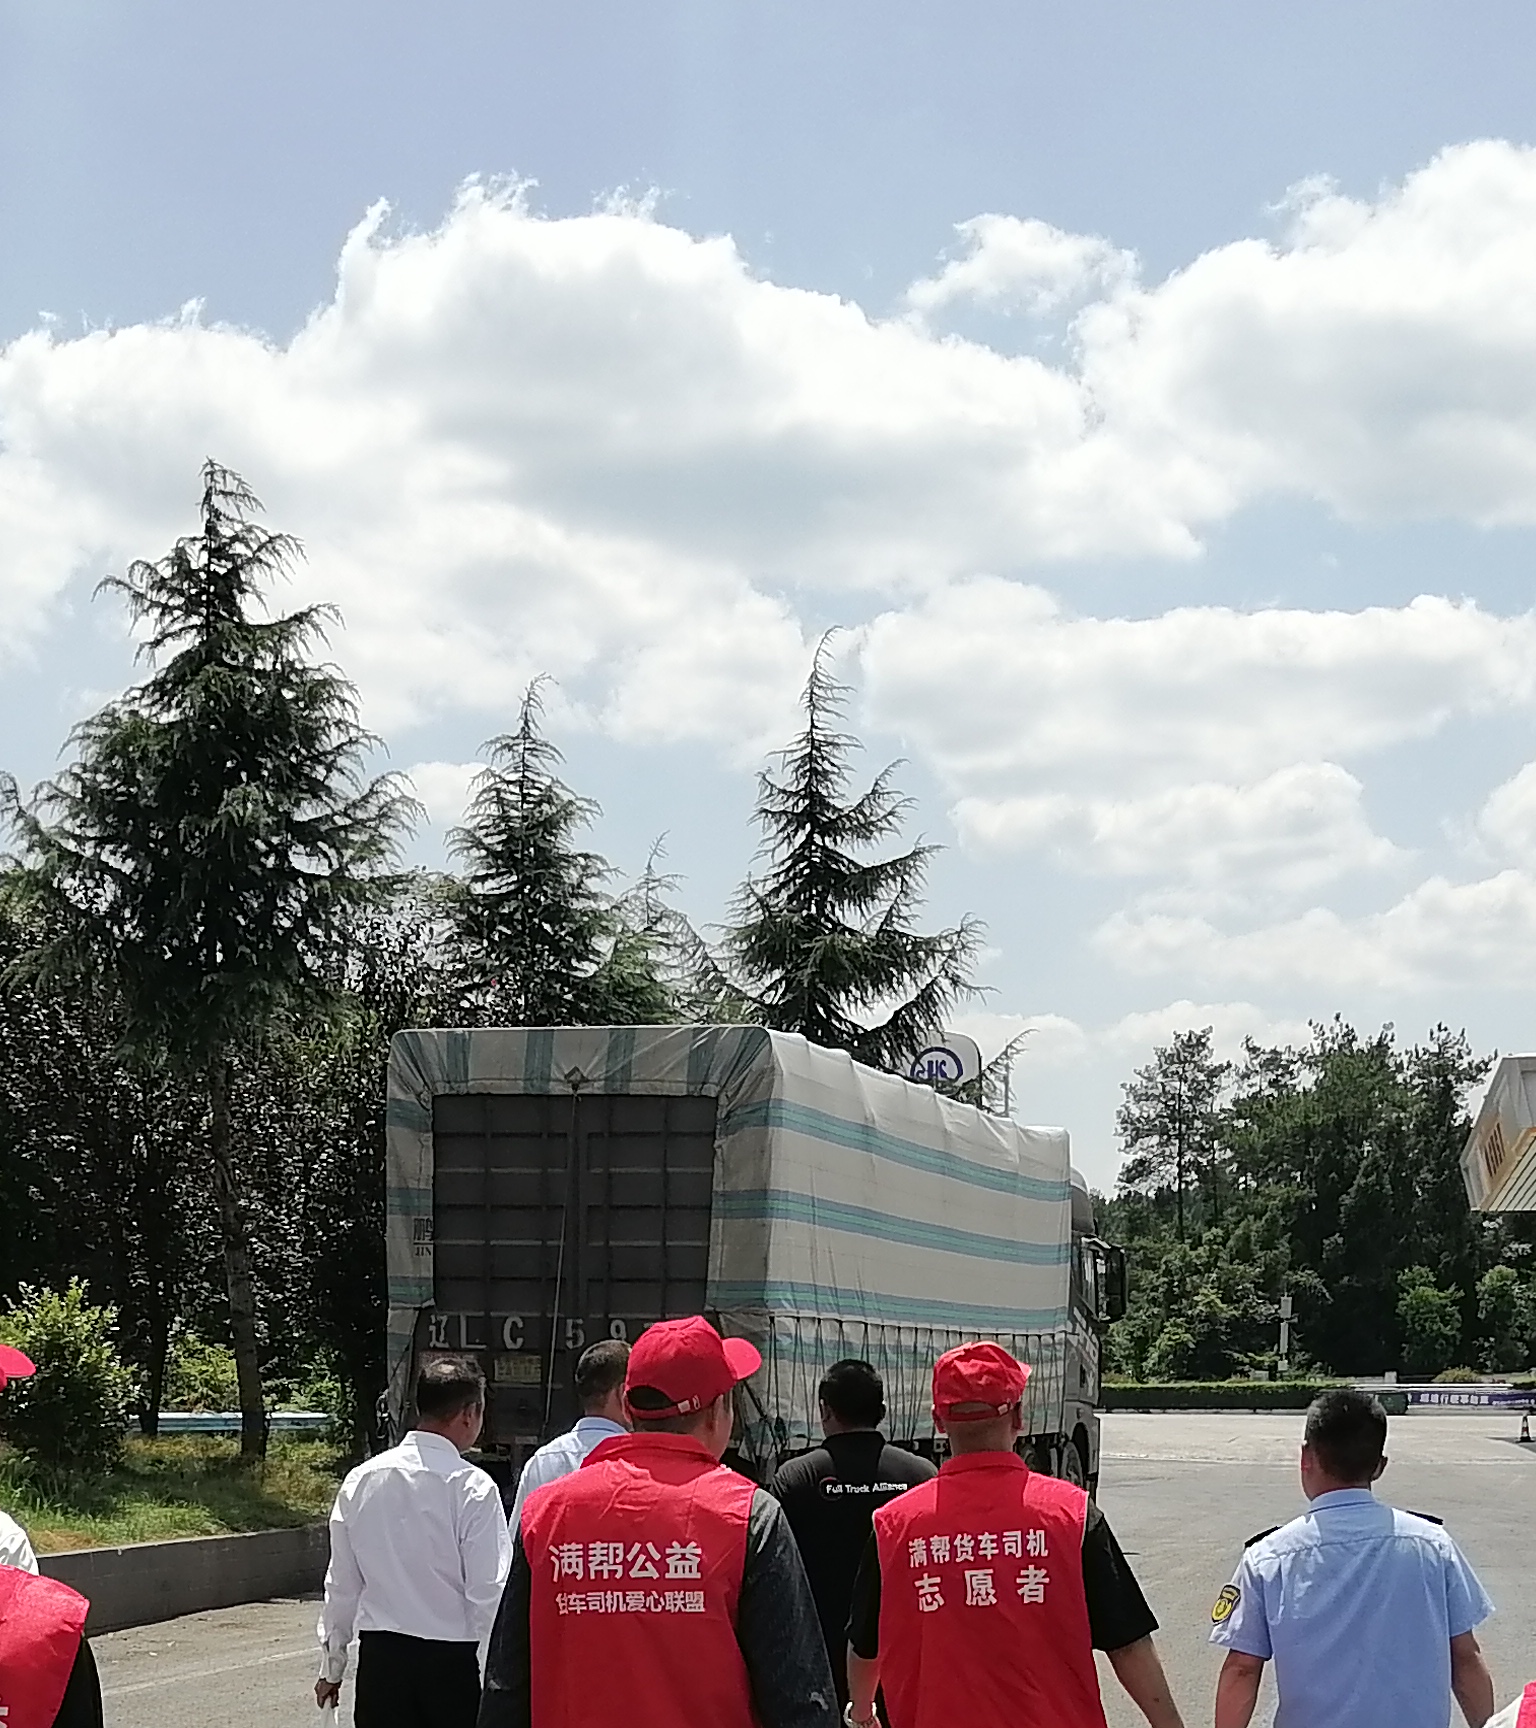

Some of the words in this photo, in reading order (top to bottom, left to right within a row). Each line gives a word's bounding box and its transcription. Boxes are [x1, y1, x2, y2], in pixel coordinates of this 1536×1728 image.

[826, 1484, 843, 1494] Full
[845, 1484, 870, 1493] Truck
[872, 1482, 907, 1492] Alliance
[549, 1541, 702, 1582] 满帮公益
[909, 1529, 1048, 1568] 满帮货车司机
[915, 1565, 1050, 1612] 志愿者
